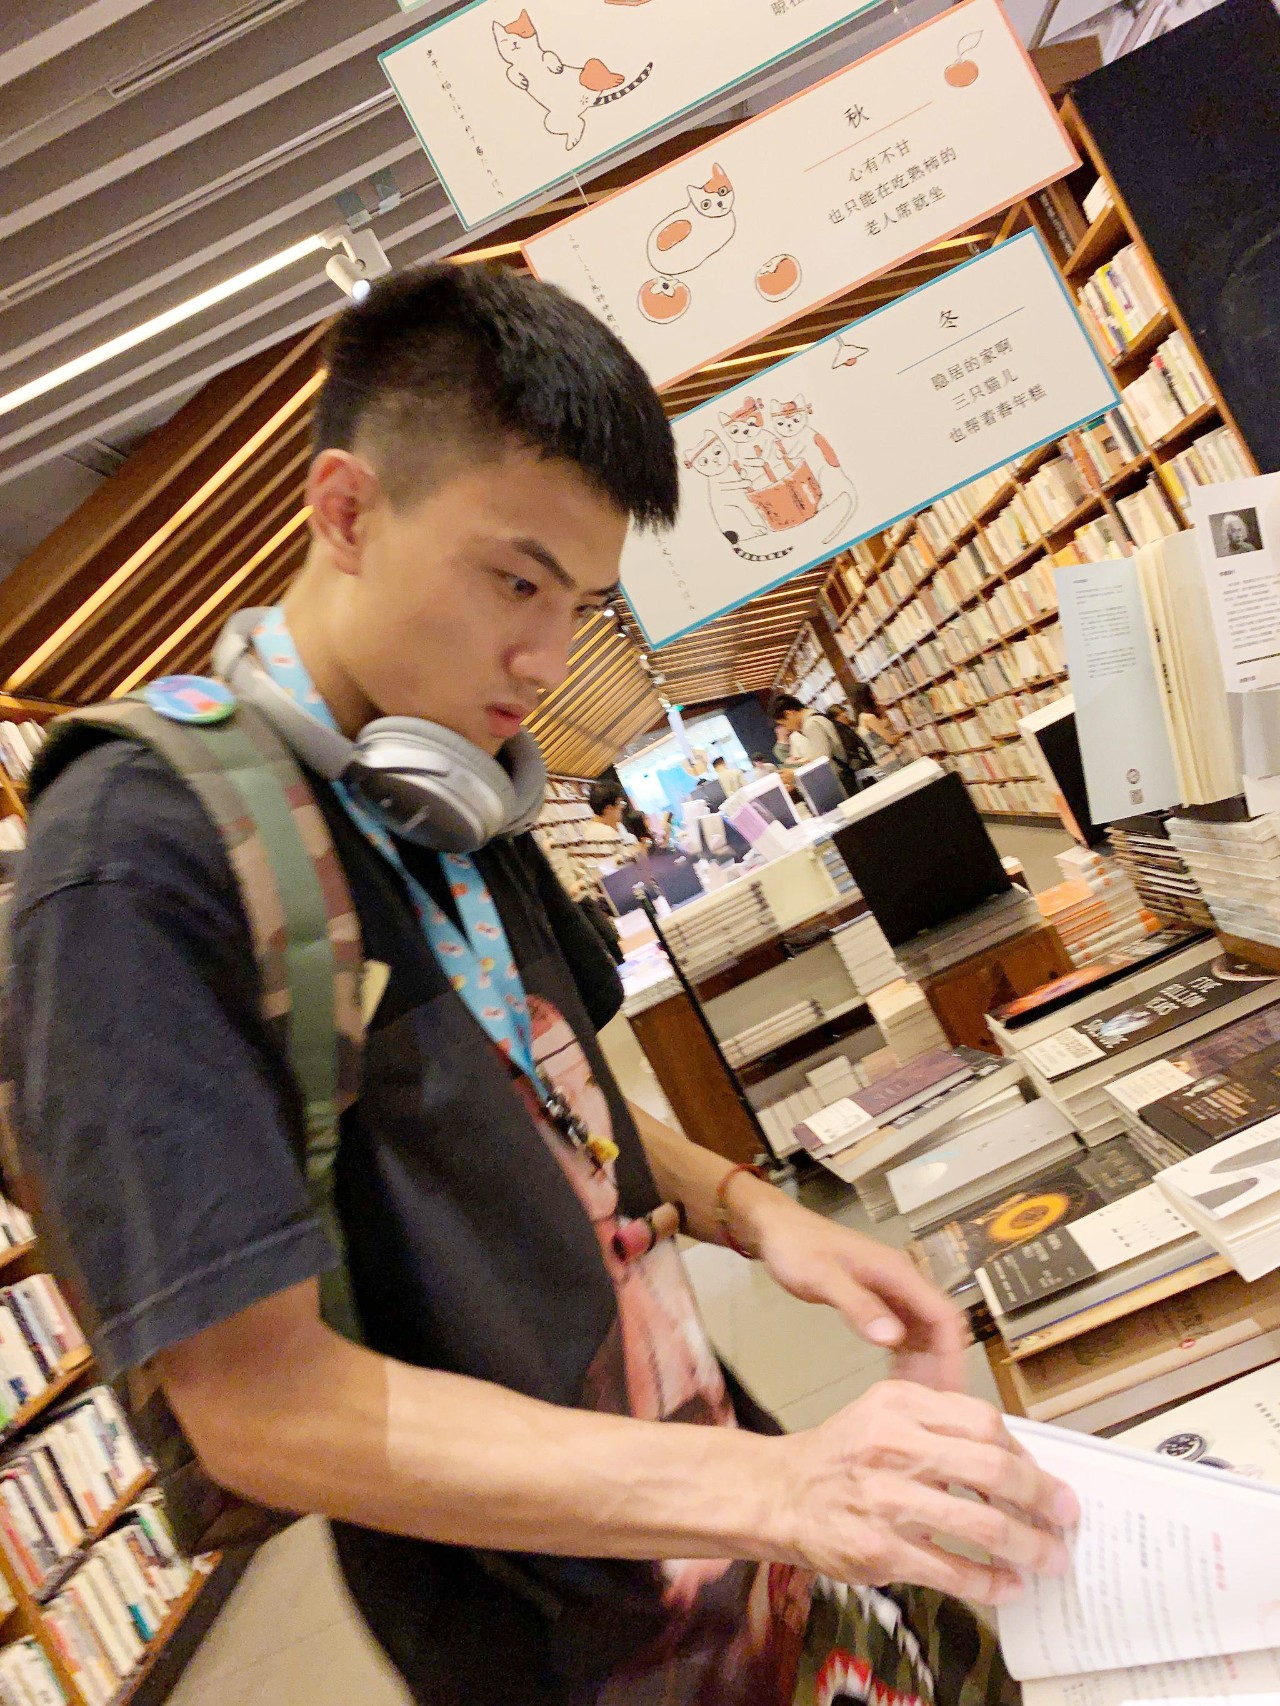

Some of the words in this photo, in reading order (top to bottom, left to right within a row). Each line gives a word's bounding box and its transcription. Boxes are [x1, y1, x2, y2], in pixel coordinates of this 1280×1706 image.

[843, 103, 870, 129] 秋
[848, 138, 911, 183] 心有不甘
[827, 146, 957, 225] 也只能在吃熟柿的
[863, 185, 946, 238] 老人席就坐
[938, 309, 959, 329] 冬
[952, 368, 1018, 411] 三只猫儿
